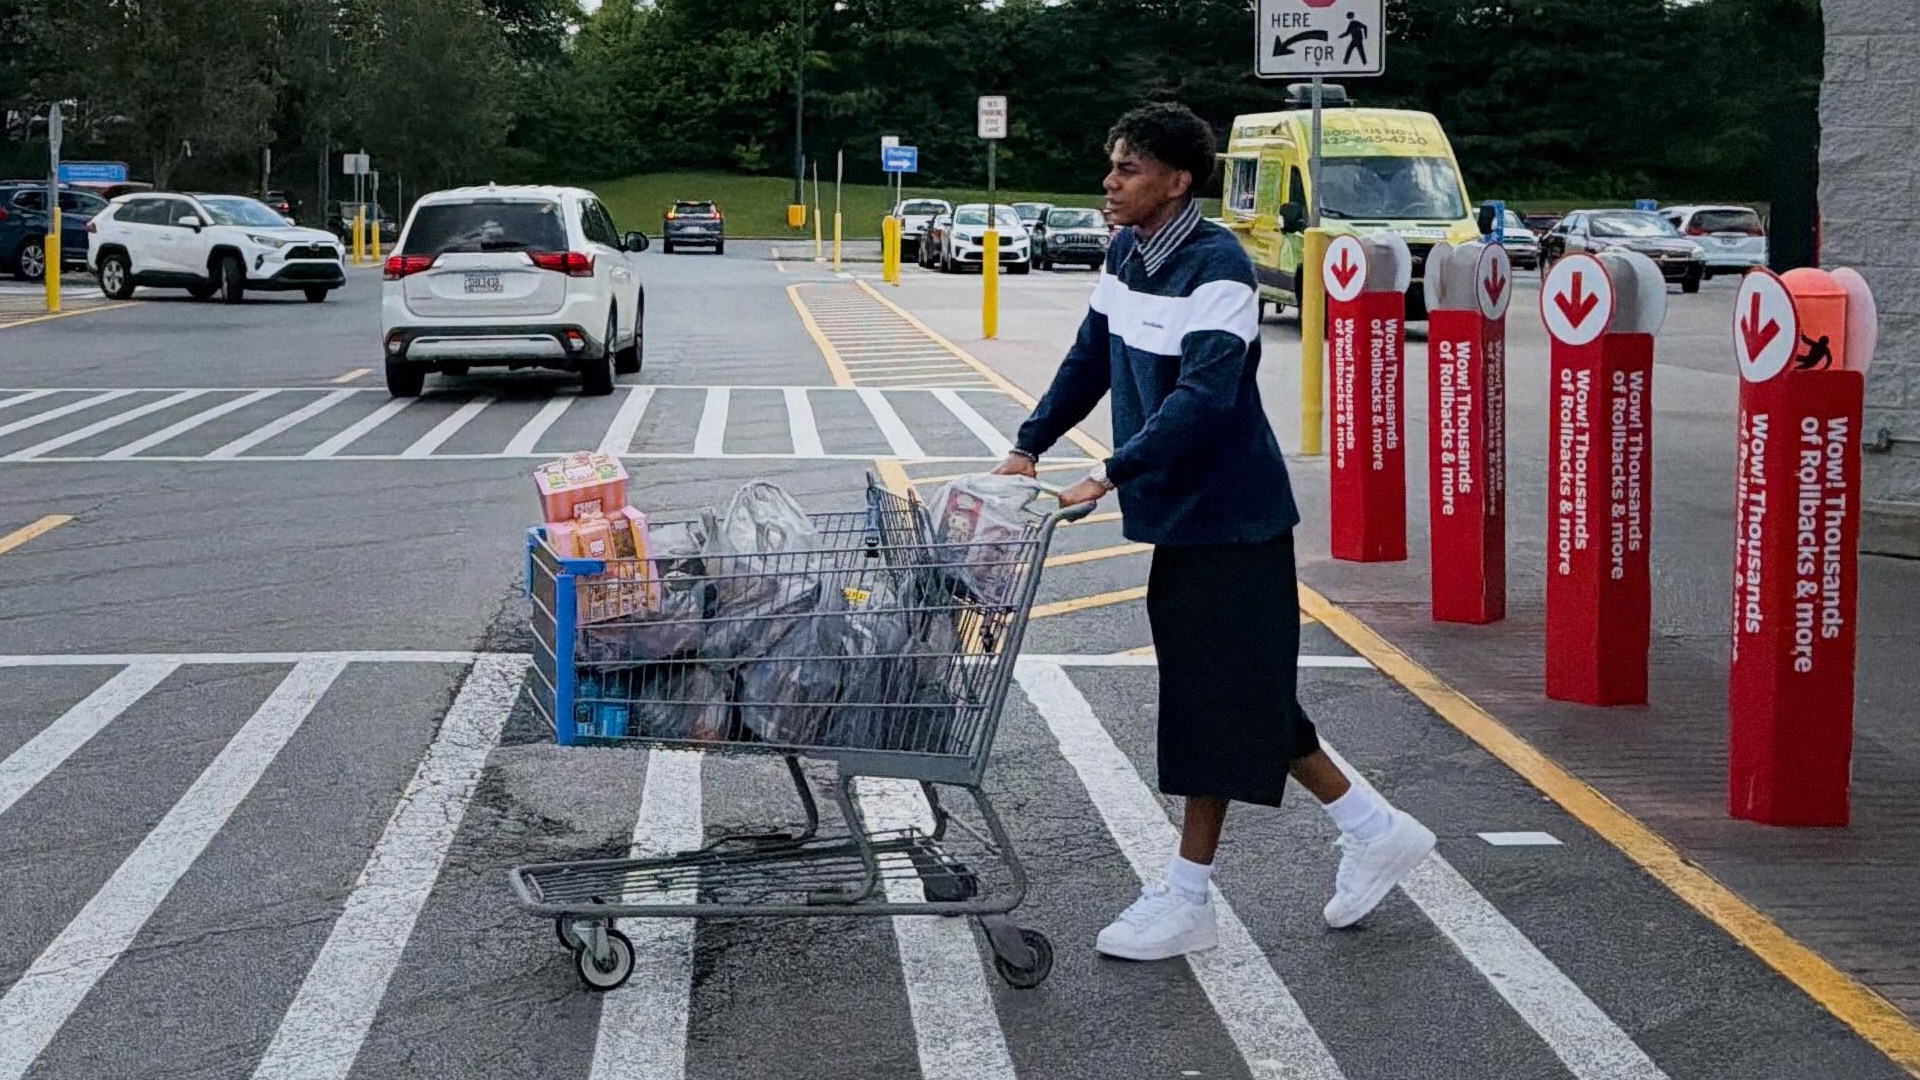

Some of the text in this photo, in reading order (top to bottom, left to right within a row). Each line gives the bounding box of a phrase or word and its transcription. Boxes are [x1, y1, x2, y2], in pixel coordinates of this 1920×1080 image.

[1271, 12, 1312, 28] HERE
[1304, 46, 1334, 62] FOR
[1335, 318, 1346, 469] of Rollbacks & more
[1344, 318, 1356, 450] Wow! Thousands
[1371, 318, 1384, 470] of Rollbacks & more
[1385, 318, 1398, 450] Wow! Thousands
[1439, 340, 1455, 515] of Rollbacks & more
[1456, 341, 1473, 494] Wow! Thousands
[1558, 368, 1574, 575] of Rollbacks & more
[1575, 369, 1591, 550] Wow! Thousands
[1628, 370, 1644, 552] Wow! Thousands
[1611, 371, 1627, 580] of Rollbacks & more
[1745, 413, 1769, 634] Wow! Thousands
[1794, 416, 1823, 673] of Rollbacks & more
[1821, 416, 1848, 639] Wow! Thousands
